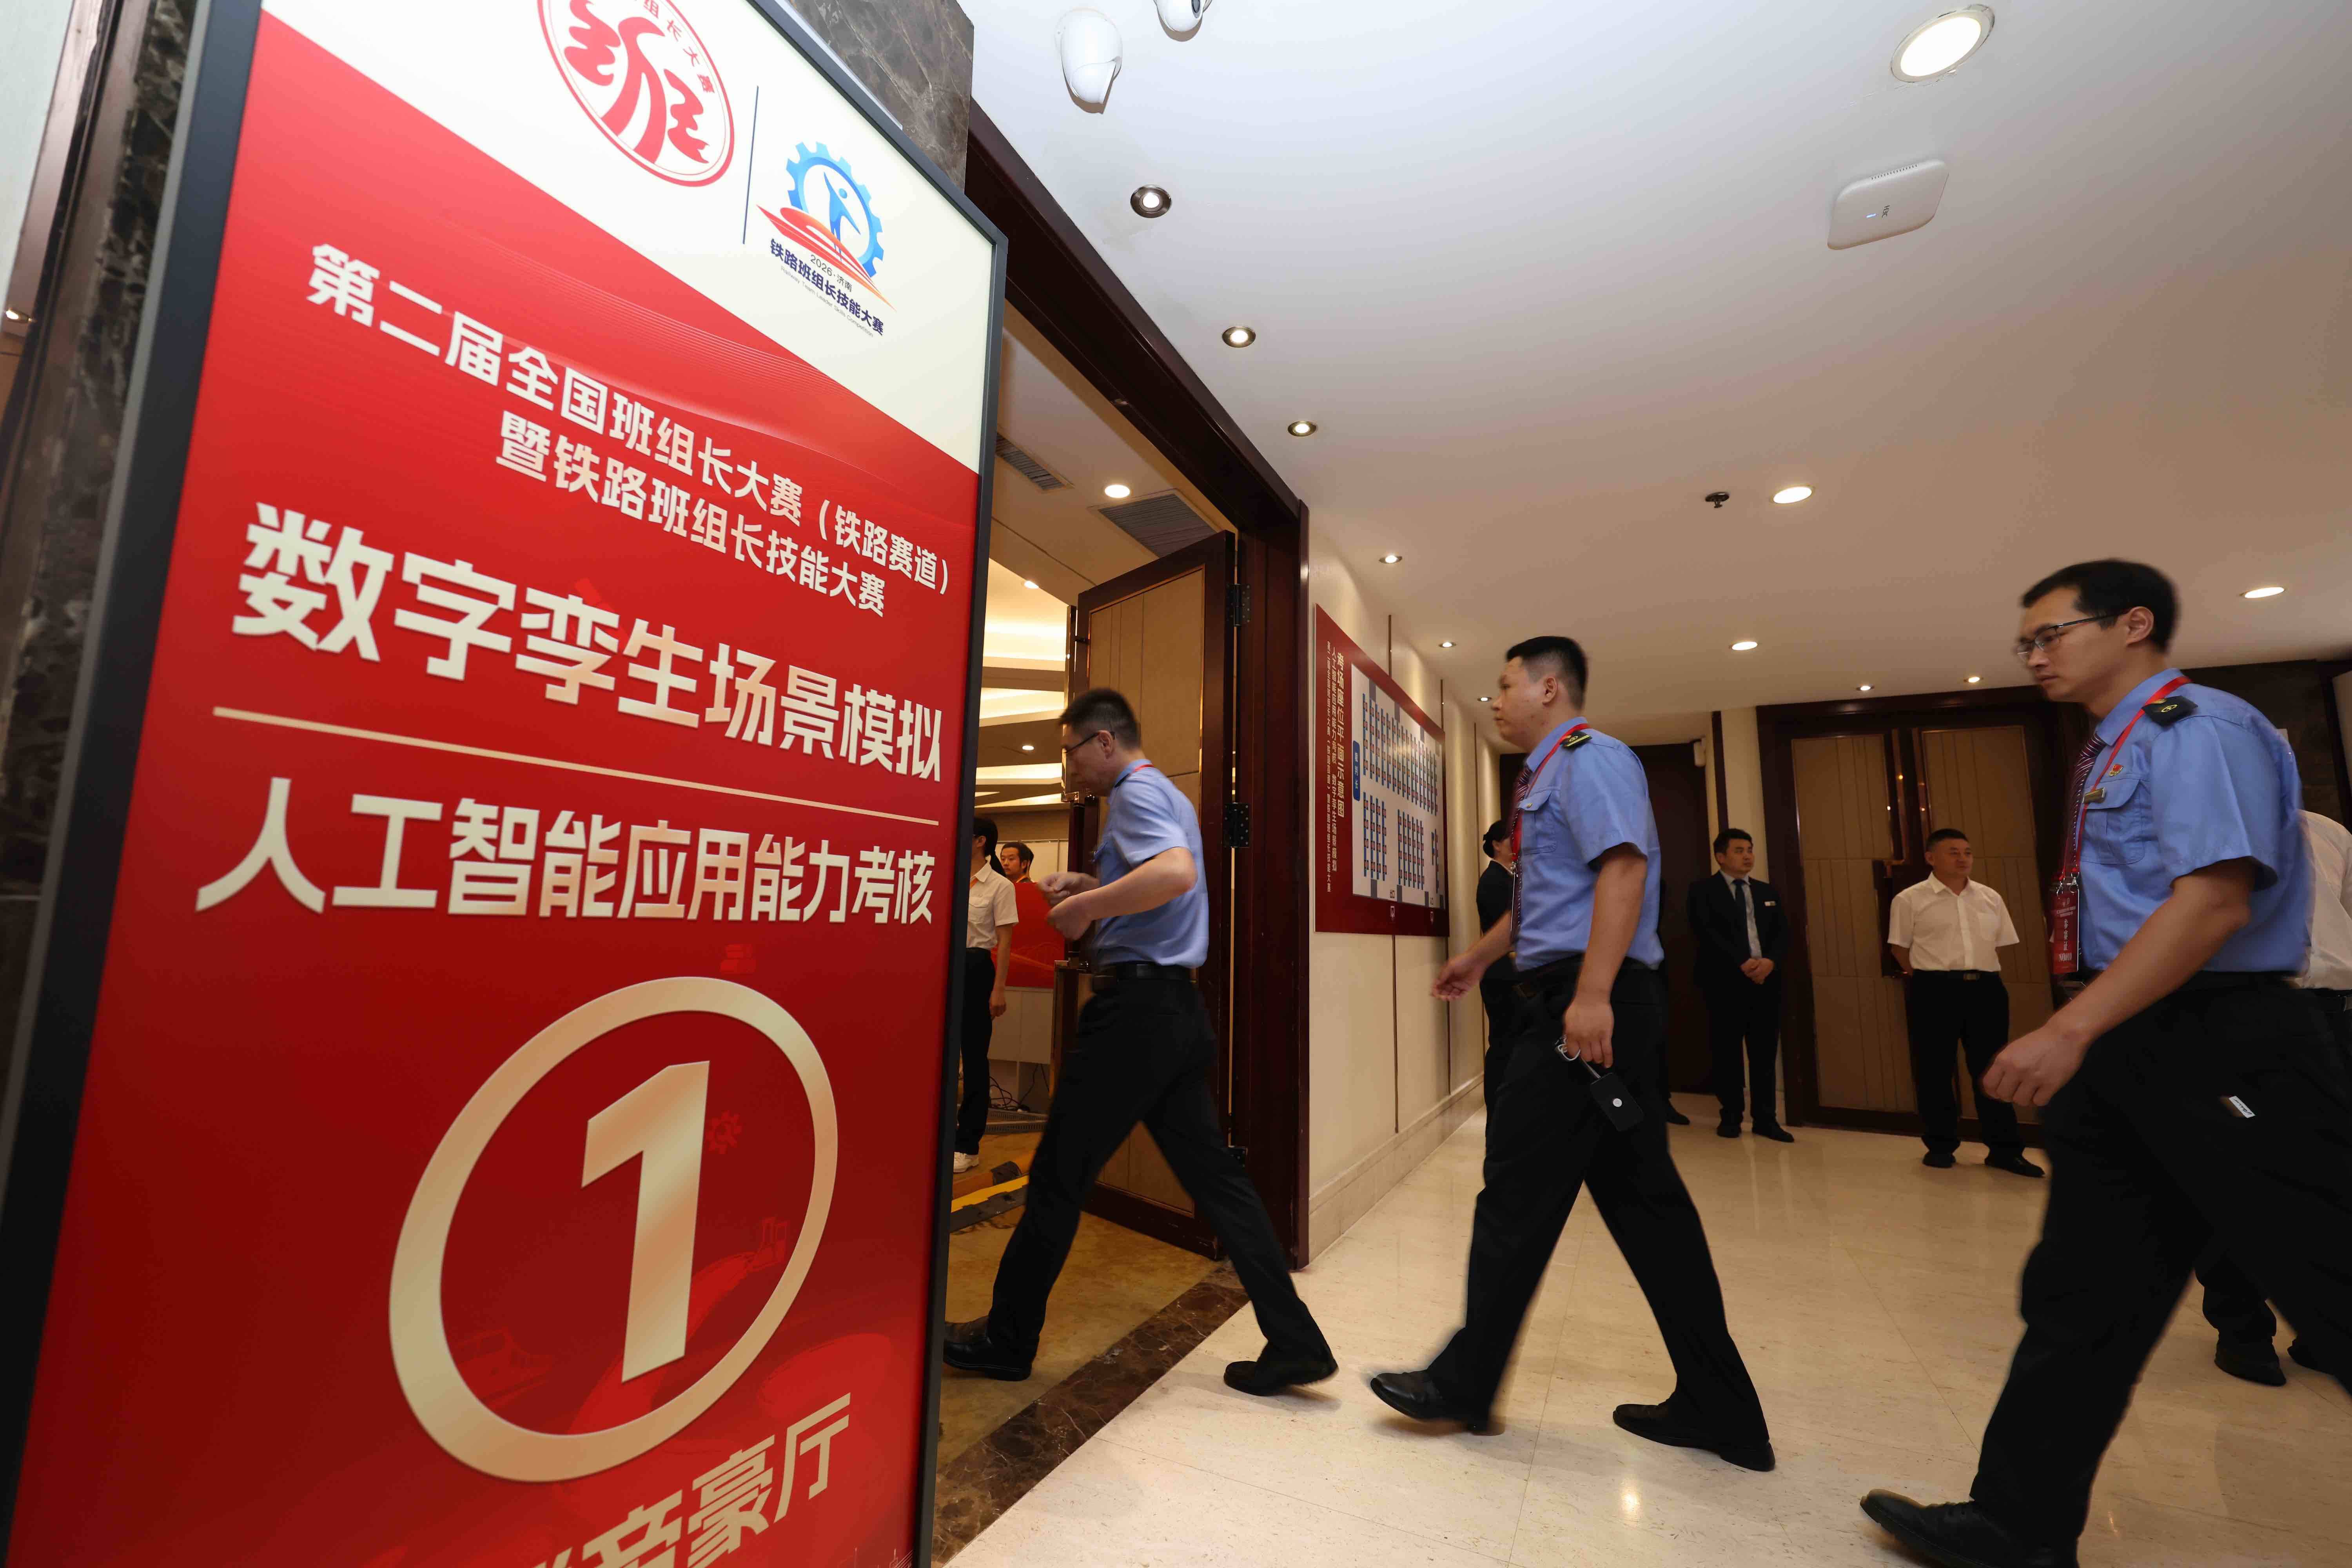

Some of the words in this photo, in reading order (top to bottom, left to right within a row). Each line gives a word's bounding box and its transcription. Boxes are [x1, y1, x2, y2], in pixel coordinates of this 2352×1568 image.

[770, 238, 884, 336] 铁路班组长技能大赛
[847, 315, 873, 338] Competition
[496, 410, 886, 617] 暨铁路班组长技能大赛
[232, 502, 942, 782] 数字孪生场景模拟
[195, 776, 935, 925] 人工智能应用能力考核
[533, 1392, 851, 1568] 帝豪厅
